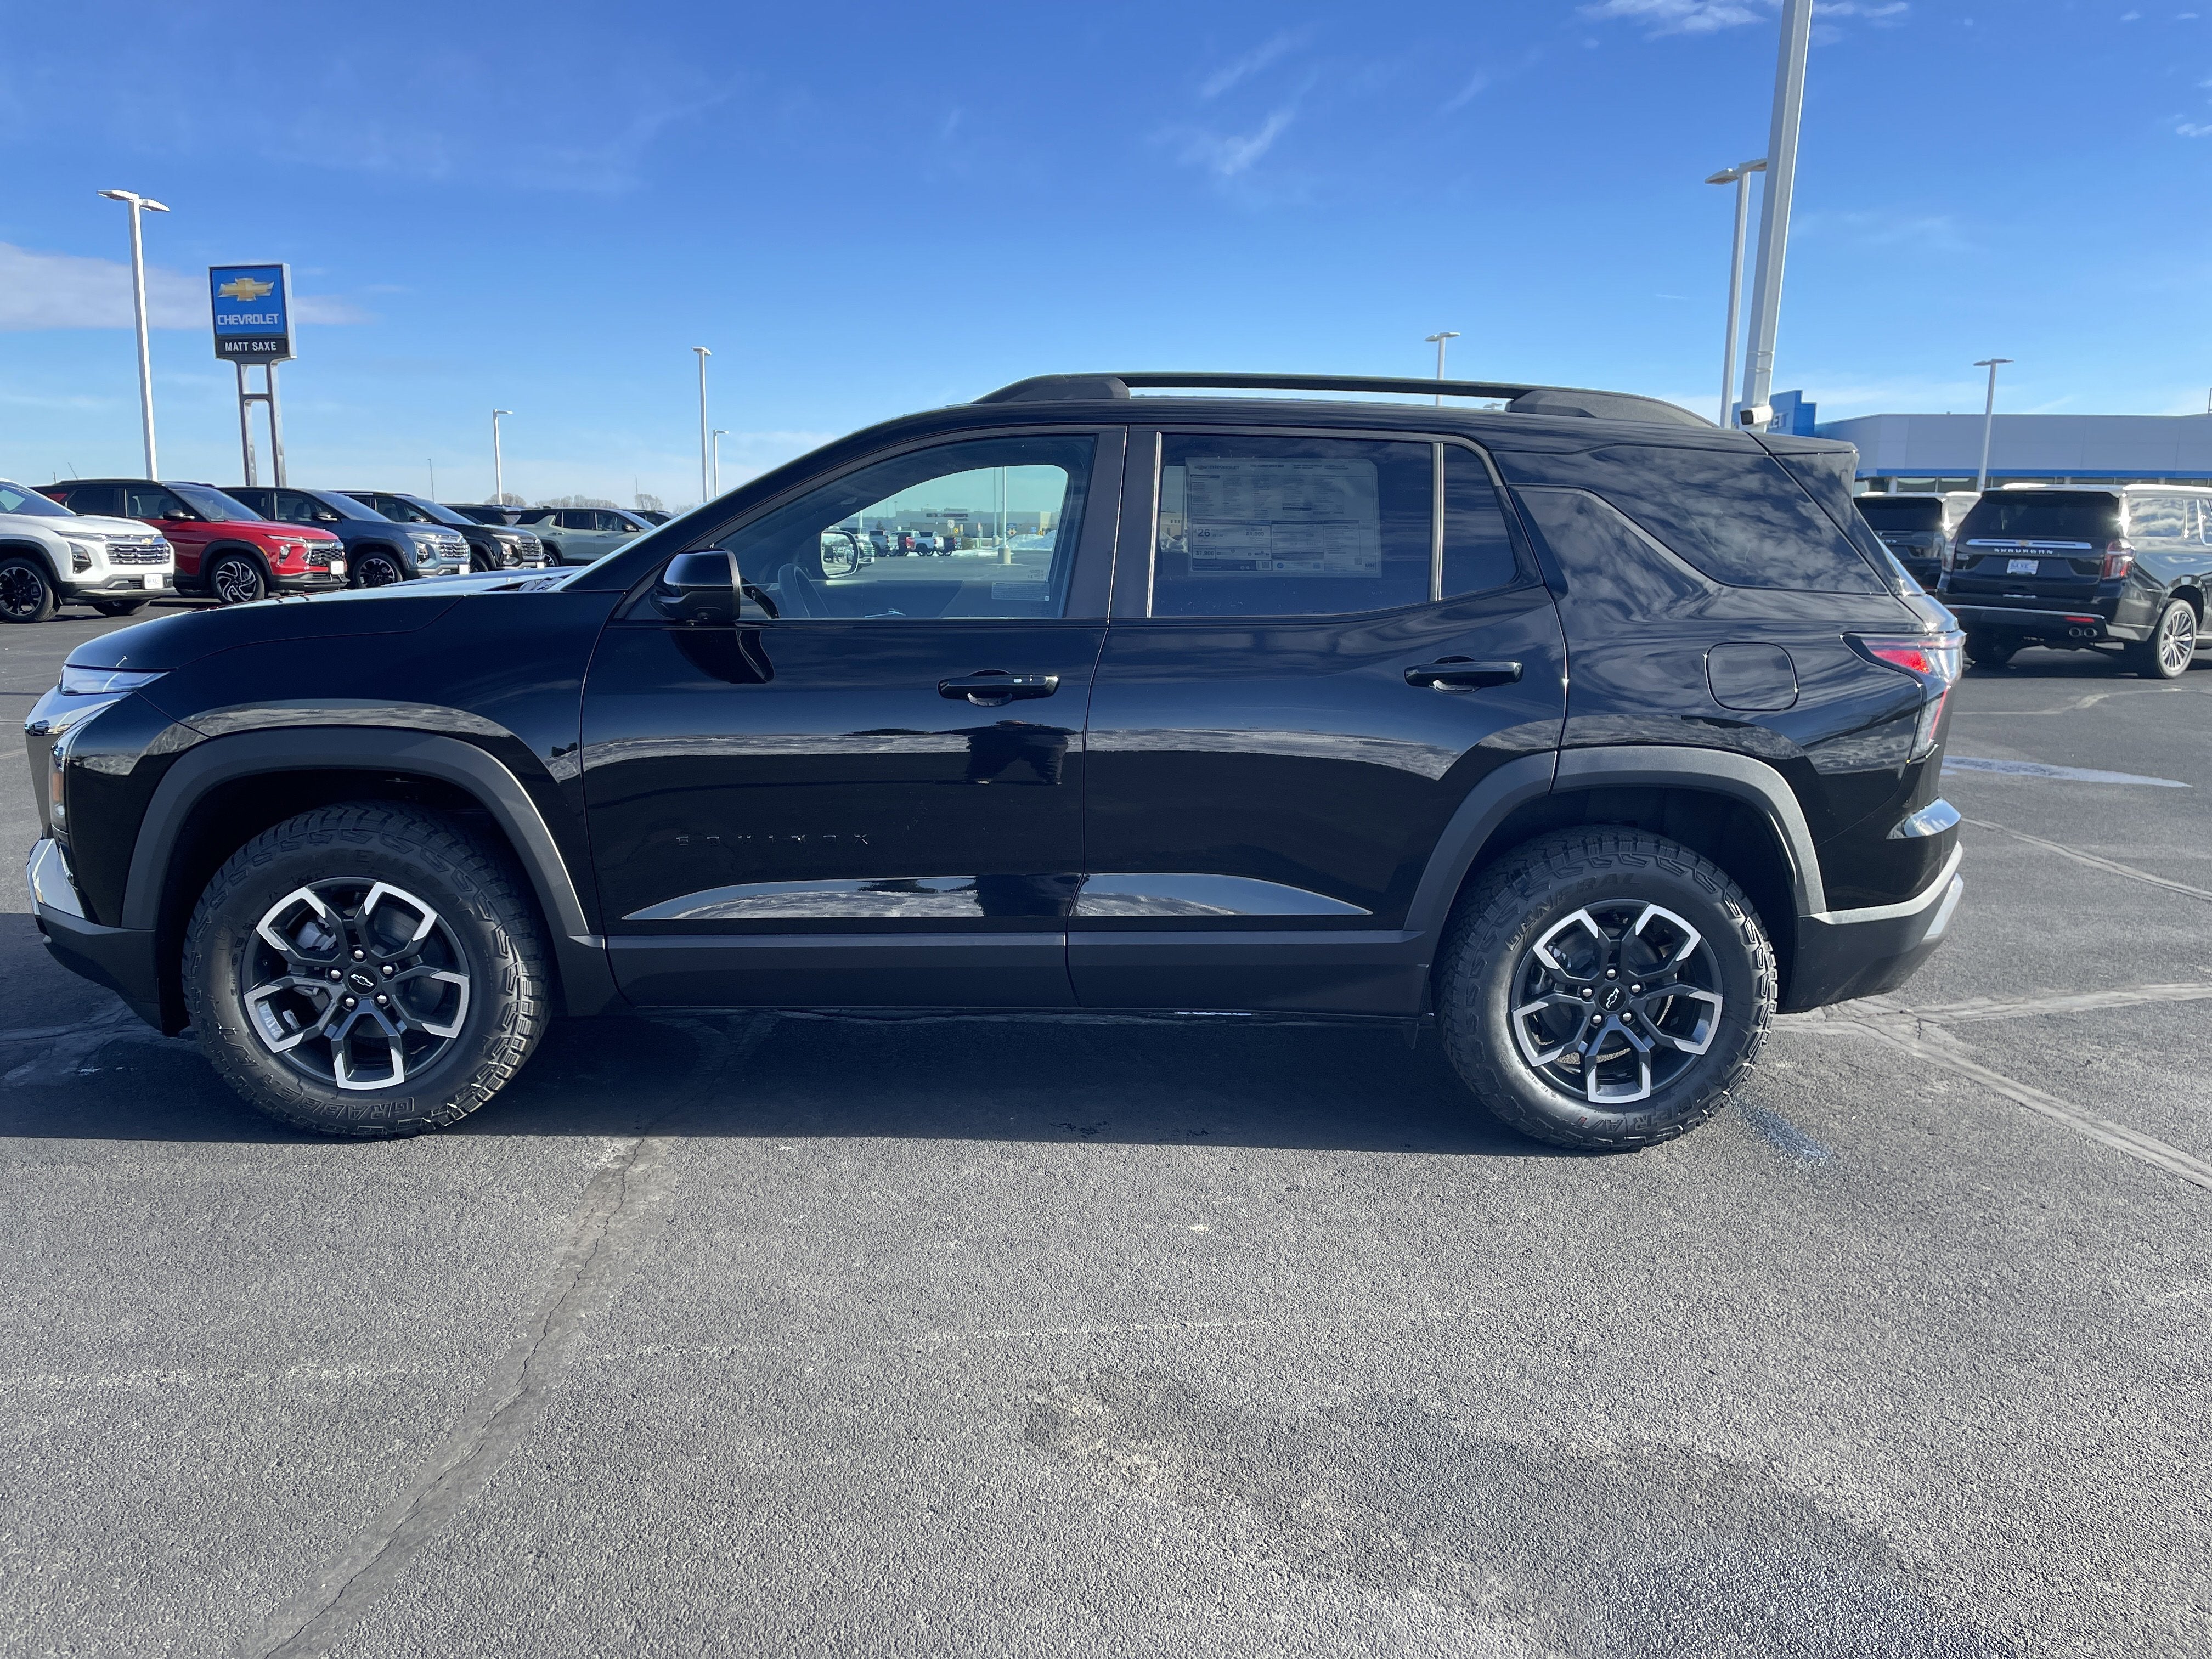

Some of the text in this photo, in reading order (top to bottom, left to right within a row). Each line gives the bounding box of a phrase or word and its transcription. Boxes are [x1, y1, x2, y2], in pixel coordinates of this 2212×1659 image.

[217, 313, 279, 325] CHEVROLET
[225, 341, 276, 351] MATT SAXE
[1197, 528, 1210, 537] 26
[676, 833, 868, 846] EQUINOX
[262, 1072, 415, 1121] GRABBER
